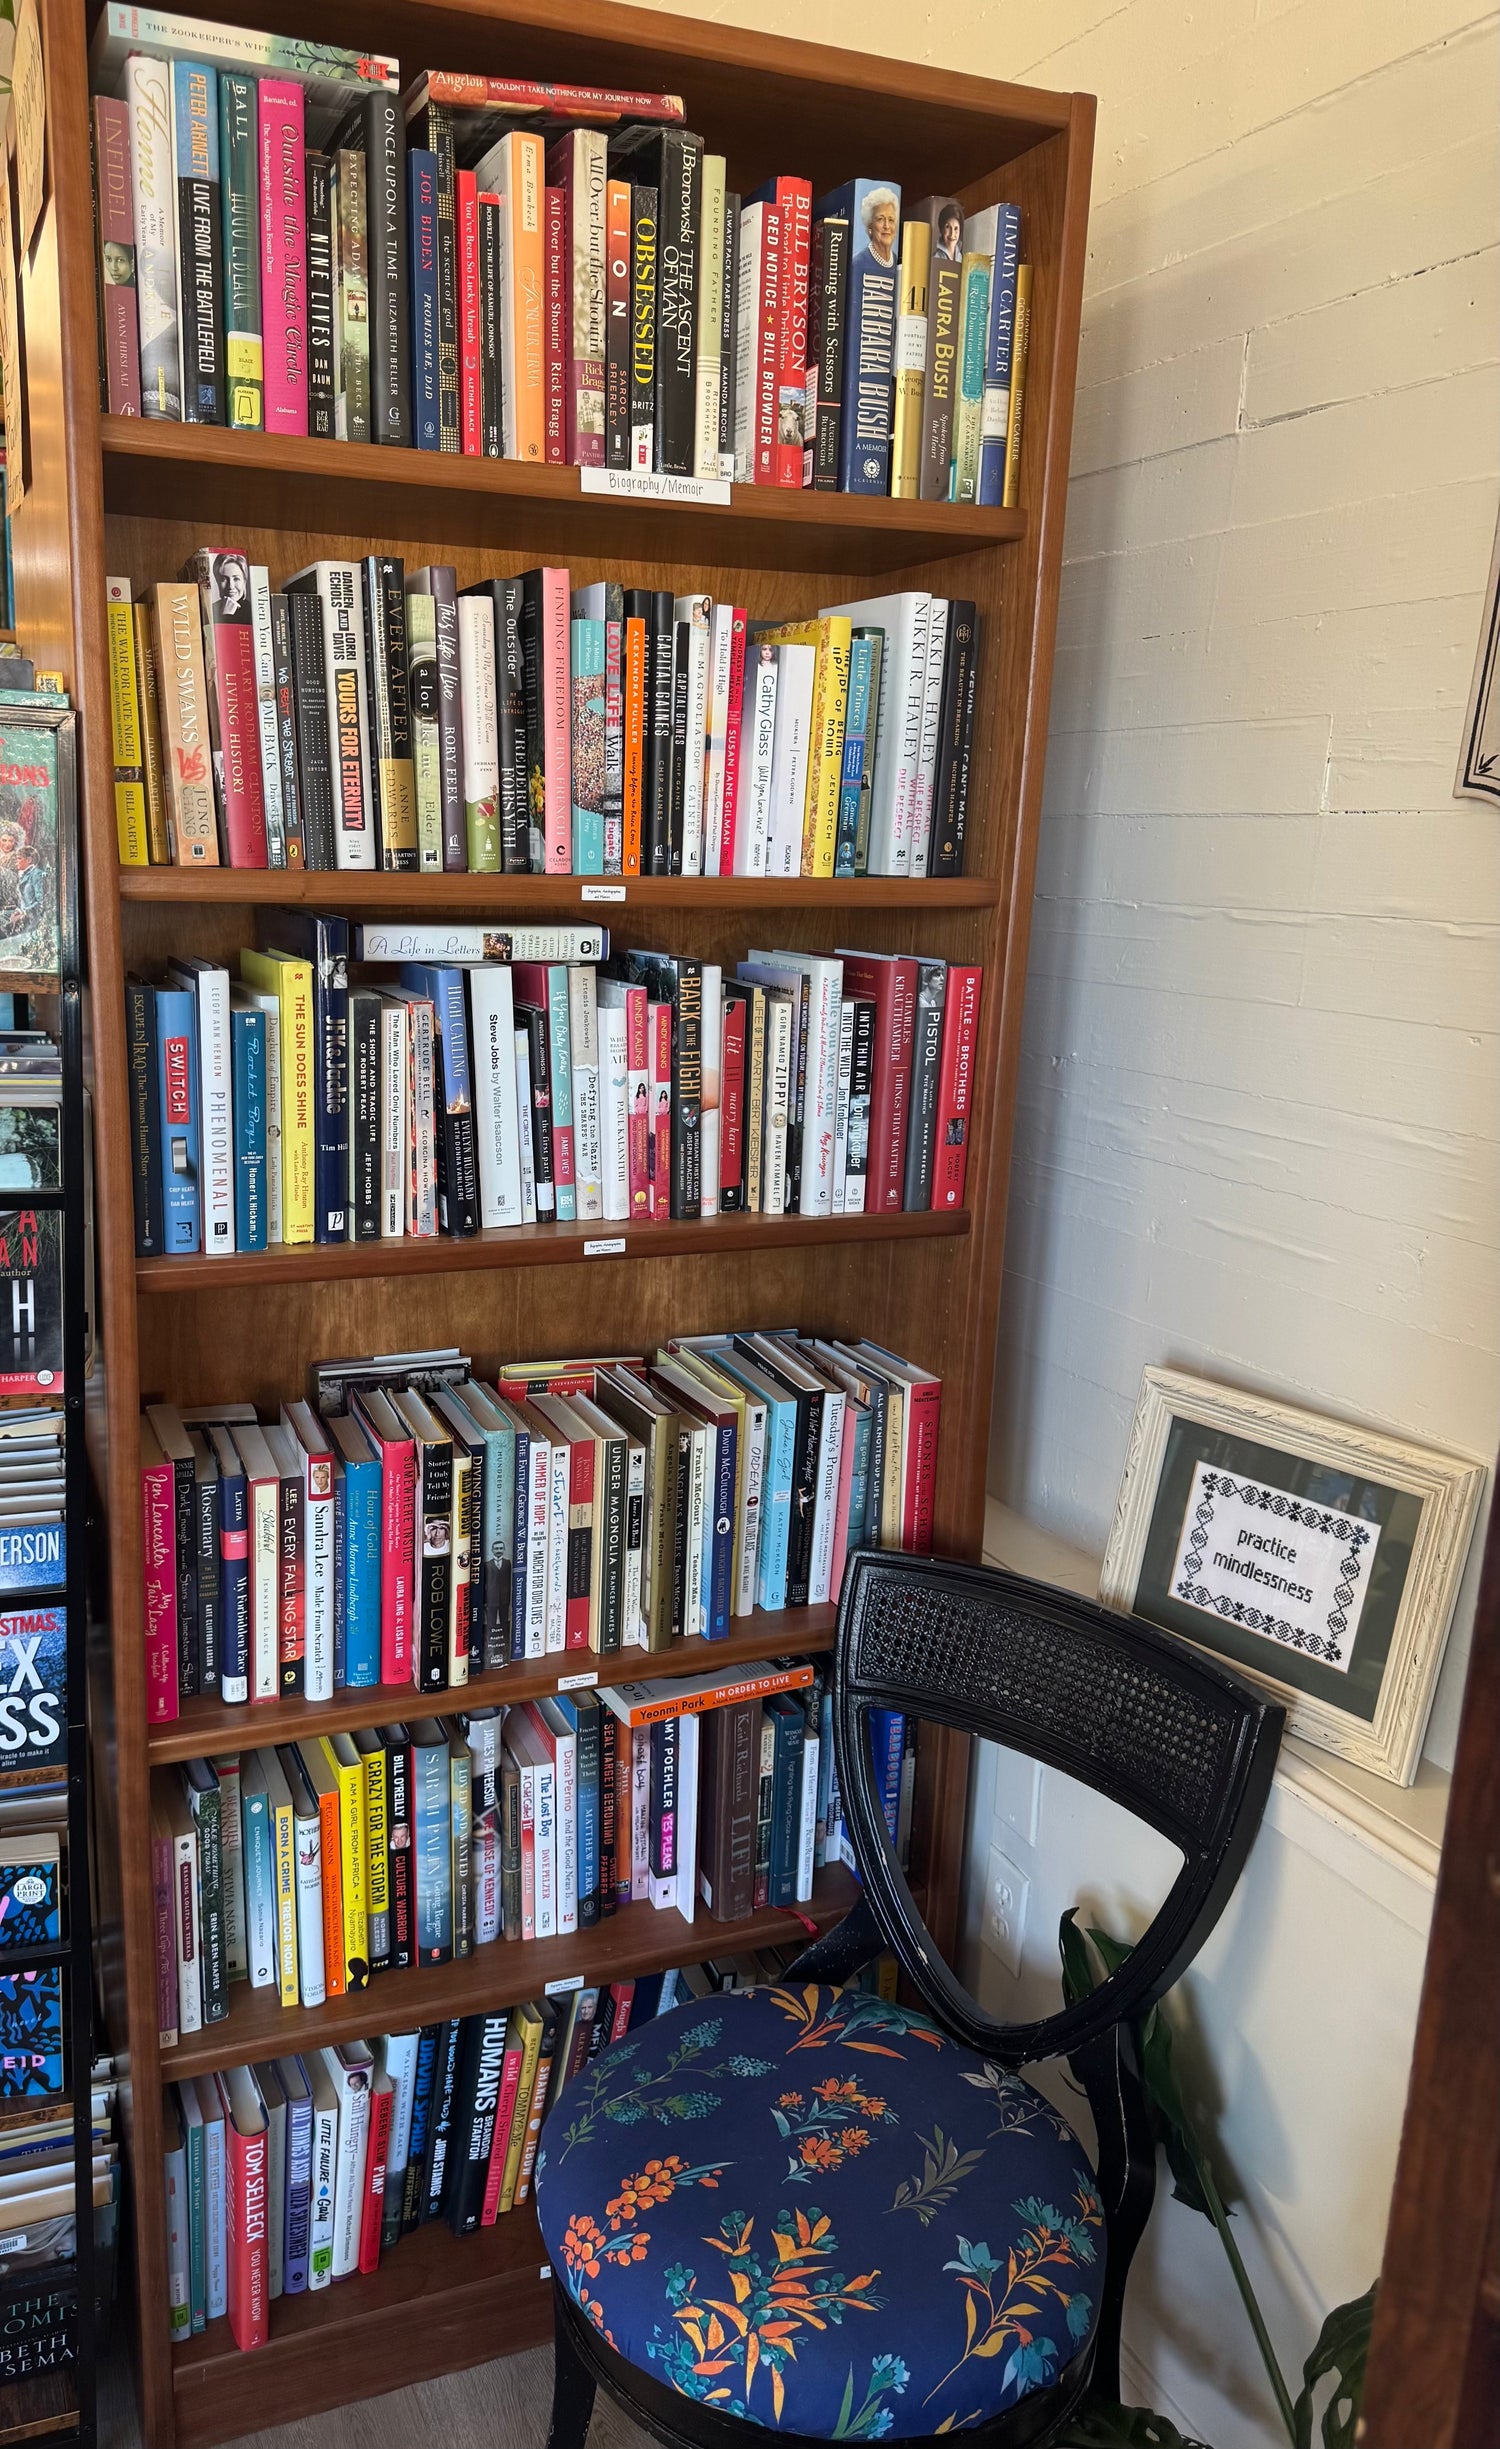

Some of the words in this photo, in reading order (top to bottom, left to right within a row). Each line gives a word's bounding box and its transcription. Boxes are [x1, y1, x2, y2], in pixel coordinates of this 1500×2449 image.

[146, 23, 167, 33] THE
[170, 28, 241, 47] ZOOKEEPER'S
[244, 42, 272, 53] WIFE
[189, 73, 206, 117] PETER
[436, 72, 482, 92] Angelou
[490, 81, 527, 92] WOULDN'T
[528, 85, 545, 94] TAKE
[546, 87, 577, 97] NOTHING
[578, 91, 591, 99] FOR
[592, 92, 603, 100] MY
[604, 94, 634, 104] JOURNEY
[635, 97, 652, 105] NOW
[190, 121, 209, 176] ARNETT
[384, 108, 396, 158] ONCE
[105, 117, 125, 221] INFIDEL
[281, 124, 299, 207] Outside
[193, 183, 210, 213] LIVE
[385, 165, 397, 215] UPON
[420, 171, 431, 204] JOE
[194, 216, 212, 256] FROM
[283, 214, 300, 248] the
[386, 224, 397, 233] A
[420, 216, 433, 271] BIDEN
[767, 215, 779, 246] RED
[794, 193, 810, 254] BILL
[310, 233, 329, 280] NINE
[386, 241, 398, 280] TIME
[1002, 211, 1018, 282] JIMMY
[195, 257, 213, 287] THE
[280, 253, 301, 320] Magic
[765, 252, 779, 308] NOTICE
[311, 292, 330, 347] LIVES
[633, 218, 657, 384] OBSESSED
[792, 262, 808, 373] BRYSON
[936, 270, 959, 339] LAURA
[196, 289, 215, 373] BATTLEFIELD
[858, 272, 894, 375] BARBARA
[995, 289, 1013, 374] CARTER
[285, 326, 302, 385] Circle
[763, 332, 775, 364] BILL
[933, 343, 955, 400] BUSH
[761, 371, 773, 445] BROWDER
[856, 381, 889, 441] BUSH
[171, 594, 191, 662] WILD
[387, 590, 405, 653] EVER
[554, 587, 566, 651] FINDING
[911, 601, 929, 660] NIKKI
[606, 621, 621, 677] LOVE
[656, 634, 672, 687] CAPITAL
[335, 672, 356, 726] YOURS
[554, 656, 566, 730] FREEDOM
[760, 675, 775, 719] Cathy
[909, 669, 923, 687] R.
[177, 664, 199, 745] SWANS
[225, 672, 239, 727] LIVING
[390, 666, 408, 745] AFTER
[606, 682, 622, 728] LIFE
[654, 693, 669, 738] GAINES
[339, 727, 358, 758] FOR
[758, 722, 772, 757] Glass
[904, 695, 921, 761] HALEY
[228, 732, 245, 795] HISTORY
[606, 736, 620, 772] Walk
[125, 790, 136, 815] BILL
[343, 760, 364, 830] ETERNITY
[127, 816, 138, 859] CARTER
[367, 938, 389, 955] A
[391, 936, 422, 956] Life
[424, 945, 435, 954] in
[438, 936, 481, 956] Letters
[295, 994, 306, 1019] THE
[447, 985, 462, 1021] HIGH
[679, 976, 701, 1023] BACK
[962, 978, 975, 1026] BATTLE
[296, 1021, 306, 1050] SUN
[489, 1014, 498, 1043] Steve
[685, 1023, 697, 1032] IN
[685, 1033, 698, 1048] THE
[858, 1011, 871, 1038] INTO
[924, 1011, 941, 1066] PISTOL
[963, 1029, 970, 1044] OF
[296, 1053, 306, 1088] DOES
[449, 1024, 465, 1077] CALLING
[491, 1045, 500, 1070] Jobs
[857, 1043, 869, 1069] THIN
[167, 1043, 188, 1114] SWITCH
[490, 1072, 501, 1085] by
[679, 1050, 700, 1100] FIGHT
[775, 1066, 786, 1107] ZIPPY
[854, 1072, 867, 1092] AIR
[956, 1045, 970, 1110] BROTHERS
[296, 1091, 307, 1129] SHINE
[493, 1086, 502, 1119] Walter
[210, 1091, 228, 1212] PHENOMENAL
[494, 1120, 503, 1166] Isaacson
[0, 1269, 31, 1277] author
[722, 1429, 732, 1455] DAVID
[146, 1474, 168, 1500] Jen
[609, 1446, 623, 1492] UNDER
[152, 1502, 170, 1569] Lancaster
[198, 1484, 217, 1559] Rosemary
[284, 1518, 296, 1560] EVERY
[313, 1506, 330, 1553] Sandra
[608, 1495, 620, 1567] MAGNOLIA
[314, 1554, 327, 1578] Lee
[1236, 1529, 1297, 1564] practice
[282, 1564, 297, 1622] FALLING
[315, 1586, 325, 1608] Made
[431, 1565, 444, 1604] ROB
[1213, 1552, 1313, 1604] mindlessness
[283, 1624, 297, 1659] STAR
[315, 1610, 325, 1632] From
[430, 1608, 444, 1657] LOWE
[315, 1633, 325, 1663] Scratch
[716, 1690, 725, 1699] IN
[727, 1685, 756, 1697] ORDER
[772, 1675, 790, 1685] LIVE
[640, 1704, 679, 1720] Yeonmi
[681, 1697, 705, 1711] Park
[366, 1759, 383, 1804] CRAZY
[392, 1754, 404, 1776] BILL
[540, 1774, 552, 1791] The
[393, 1777, 406, 1817] O'REILLY
[539, 1794, 551, 1817] Lost
[279, 1816, 289, 1848] BORN
[368, 1806, 384, 1834] FOR
[538, 1819, 550, 1837] Boy
[662, 1812, 674, 1832] YES
[281, 1850, 289, 1858] A
[370, 1837, 384, 1860] THE
[662, 1834, 673, 1870] PLEASE
[281, 1860, 291, 1894] CRIME
[370, 1864, 386, 1905] STORM
[282, 1899, 293, 1942] TREVOR
[284, 1944, 294, 1975] NOAH
[474, 2017, 507, 2112] HUMANS
[321, 2118, 332, 2147] LITTLE
[468, 2117, 484, 2161] STANTON
[480, 2114, 493, 2159] BRANDON
[246, 2139, 264, 2176] TOM
[319, 2148, 330, 2183] FAILURE
[372, 2165, 385, 2194] PIMP
[246, 2177, 265, 2244] SELLECK
